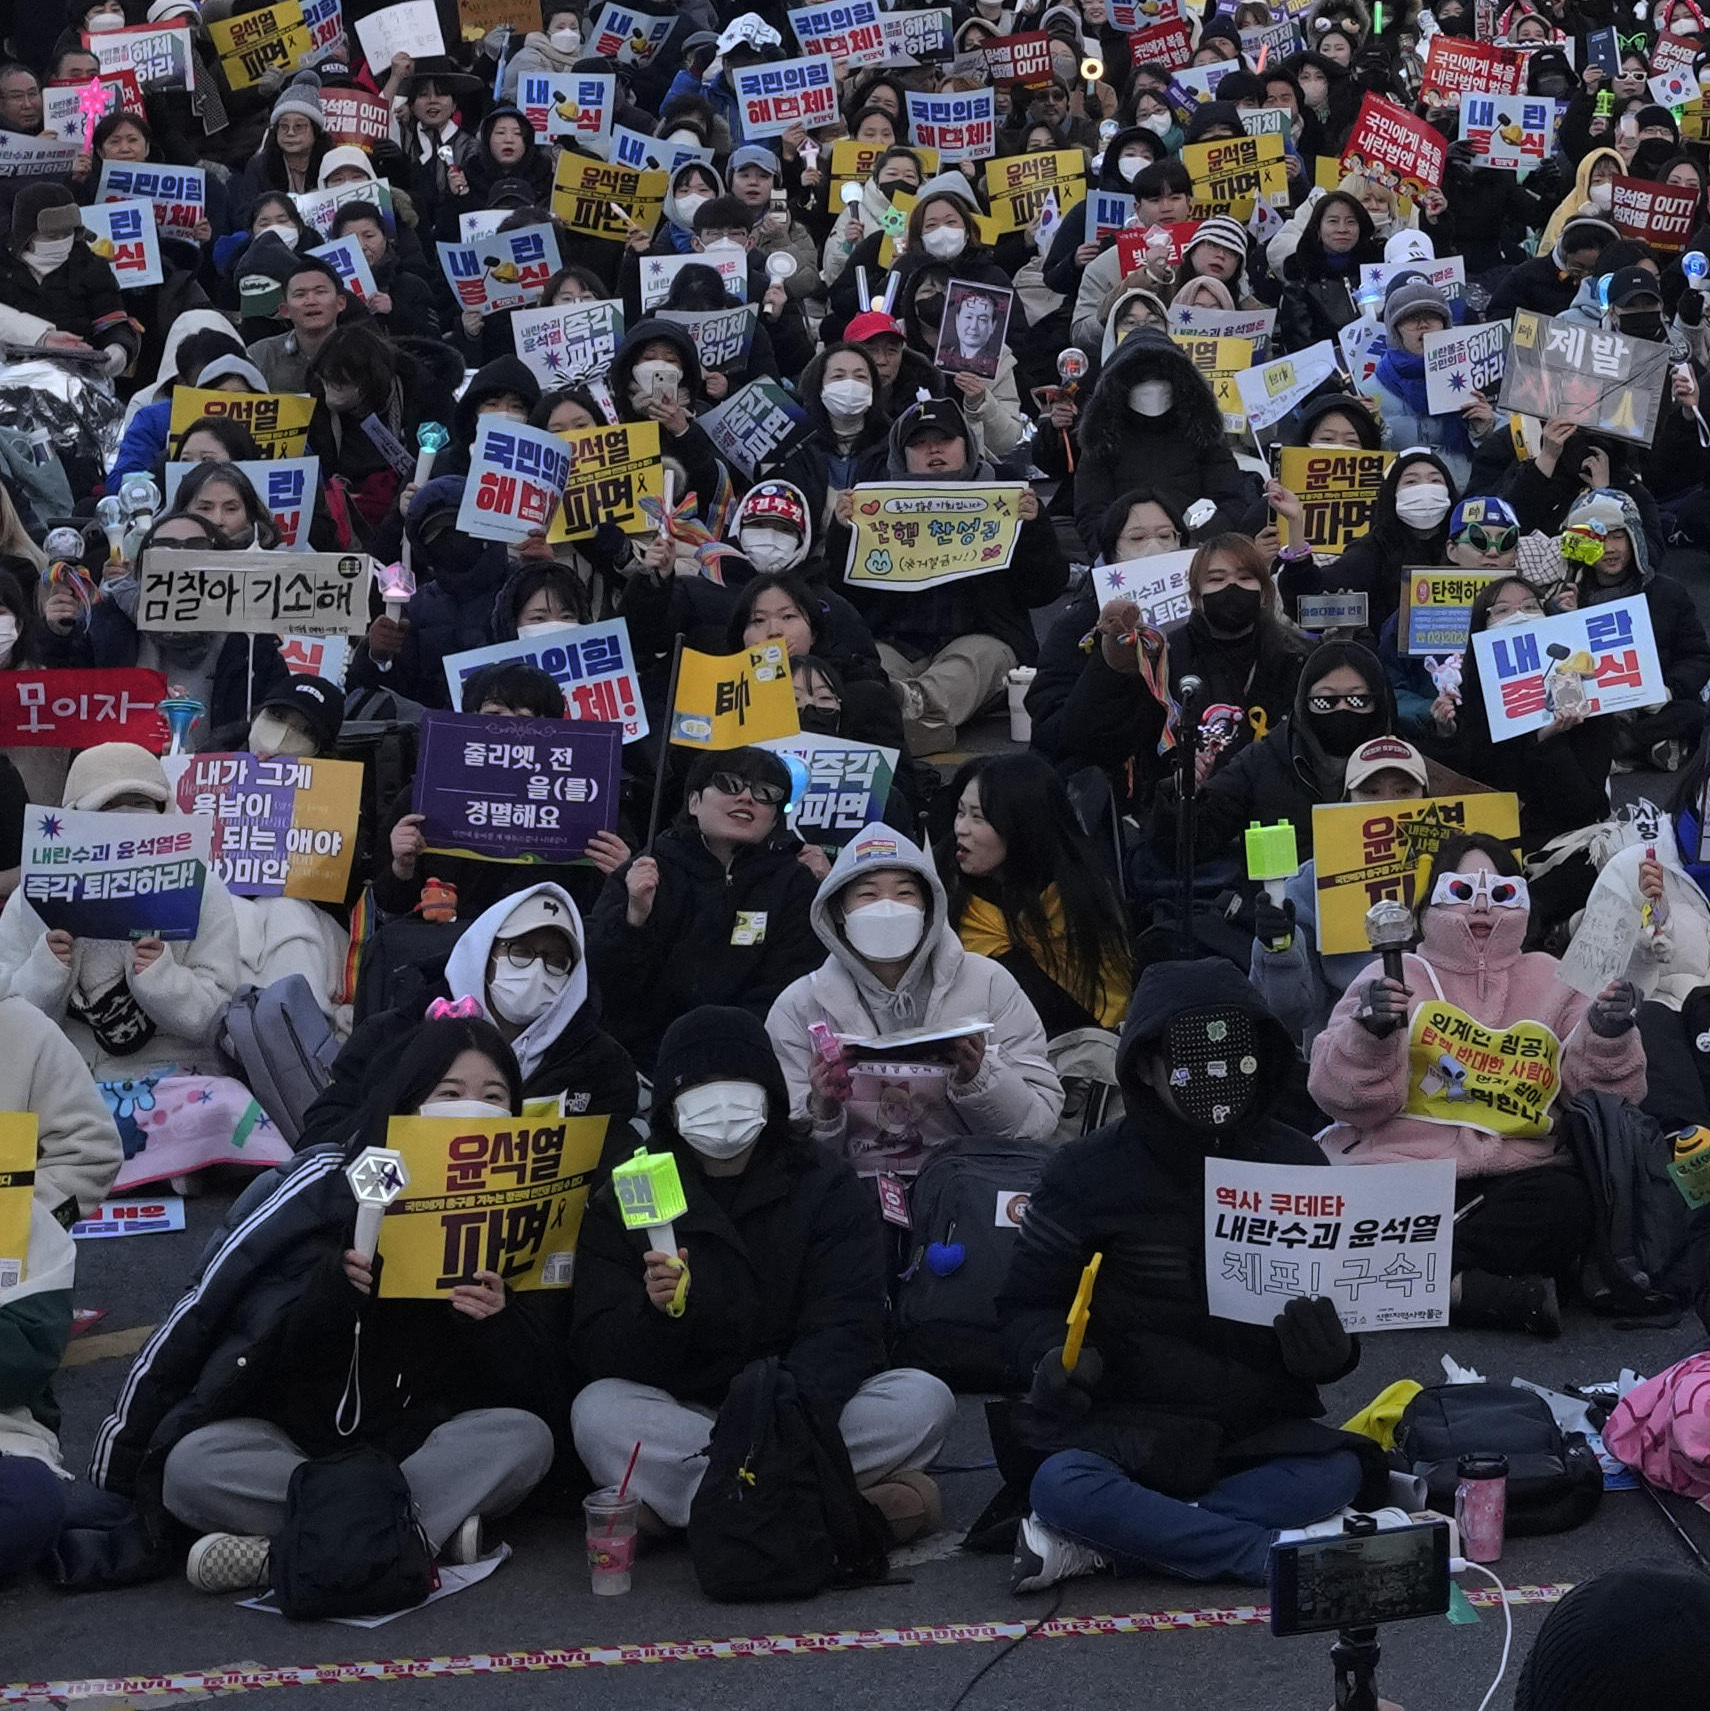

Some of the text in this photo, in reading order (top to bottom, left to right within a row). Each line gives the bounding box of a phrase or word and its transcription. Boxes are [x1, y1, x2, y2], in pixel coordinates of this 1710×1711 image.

[796, 3, 878, 34] 국민의힘
[1013, 40, 1045, 59] OUT!
[740, 61, 830, 95] 국민의힘
[1017, 58, 1049, 78] OUT!
[1430, 68, 1487, 93] 내란범엔
[1434, 49, 1517, 83] 국민에게 복을
[910, 97, 991, 122] 국민의힘
[1357, 129, 1415, 170] 내란범엔
[1364, 108, 1444, 166] 국민에게 복을
[580, 165, 642, 197] 윤석열
[1613, 185, 1694, 217] 윤석열 OUT!
[1652, 215, 1690, 235] OUT!
[1547, 323, 1631, 376] 제발
[1305, 455, 1384, 488] 윤석열
[146, 570, 239, 621] 검찰아
[194, 759, 312, 790] 내가 그게
[549, 746, 574, 773] 전
[526, 775, 600, 804] 을(를)
[464, 800, 561, 829] 경멸해요
[31, 831, 193, 865] 내란수괴 윤석열은
[222, 825, 342, 857] 되는 애야
[25, 860, 196, 904] 즉각 퇴진하라!
[1455, 1042, 1508, 1080] 반대한
[446, 1123, 567, 1192] 윤석열
[1214, 1185, 1346, 1217] 역사 쿠데타
[437, 1198, 550, 1288] 파면
[1213, 1213, 1443, 1250] 내란수괴 윤석열
[1221, 1250, 1436, 1302] 체포! 구속!
